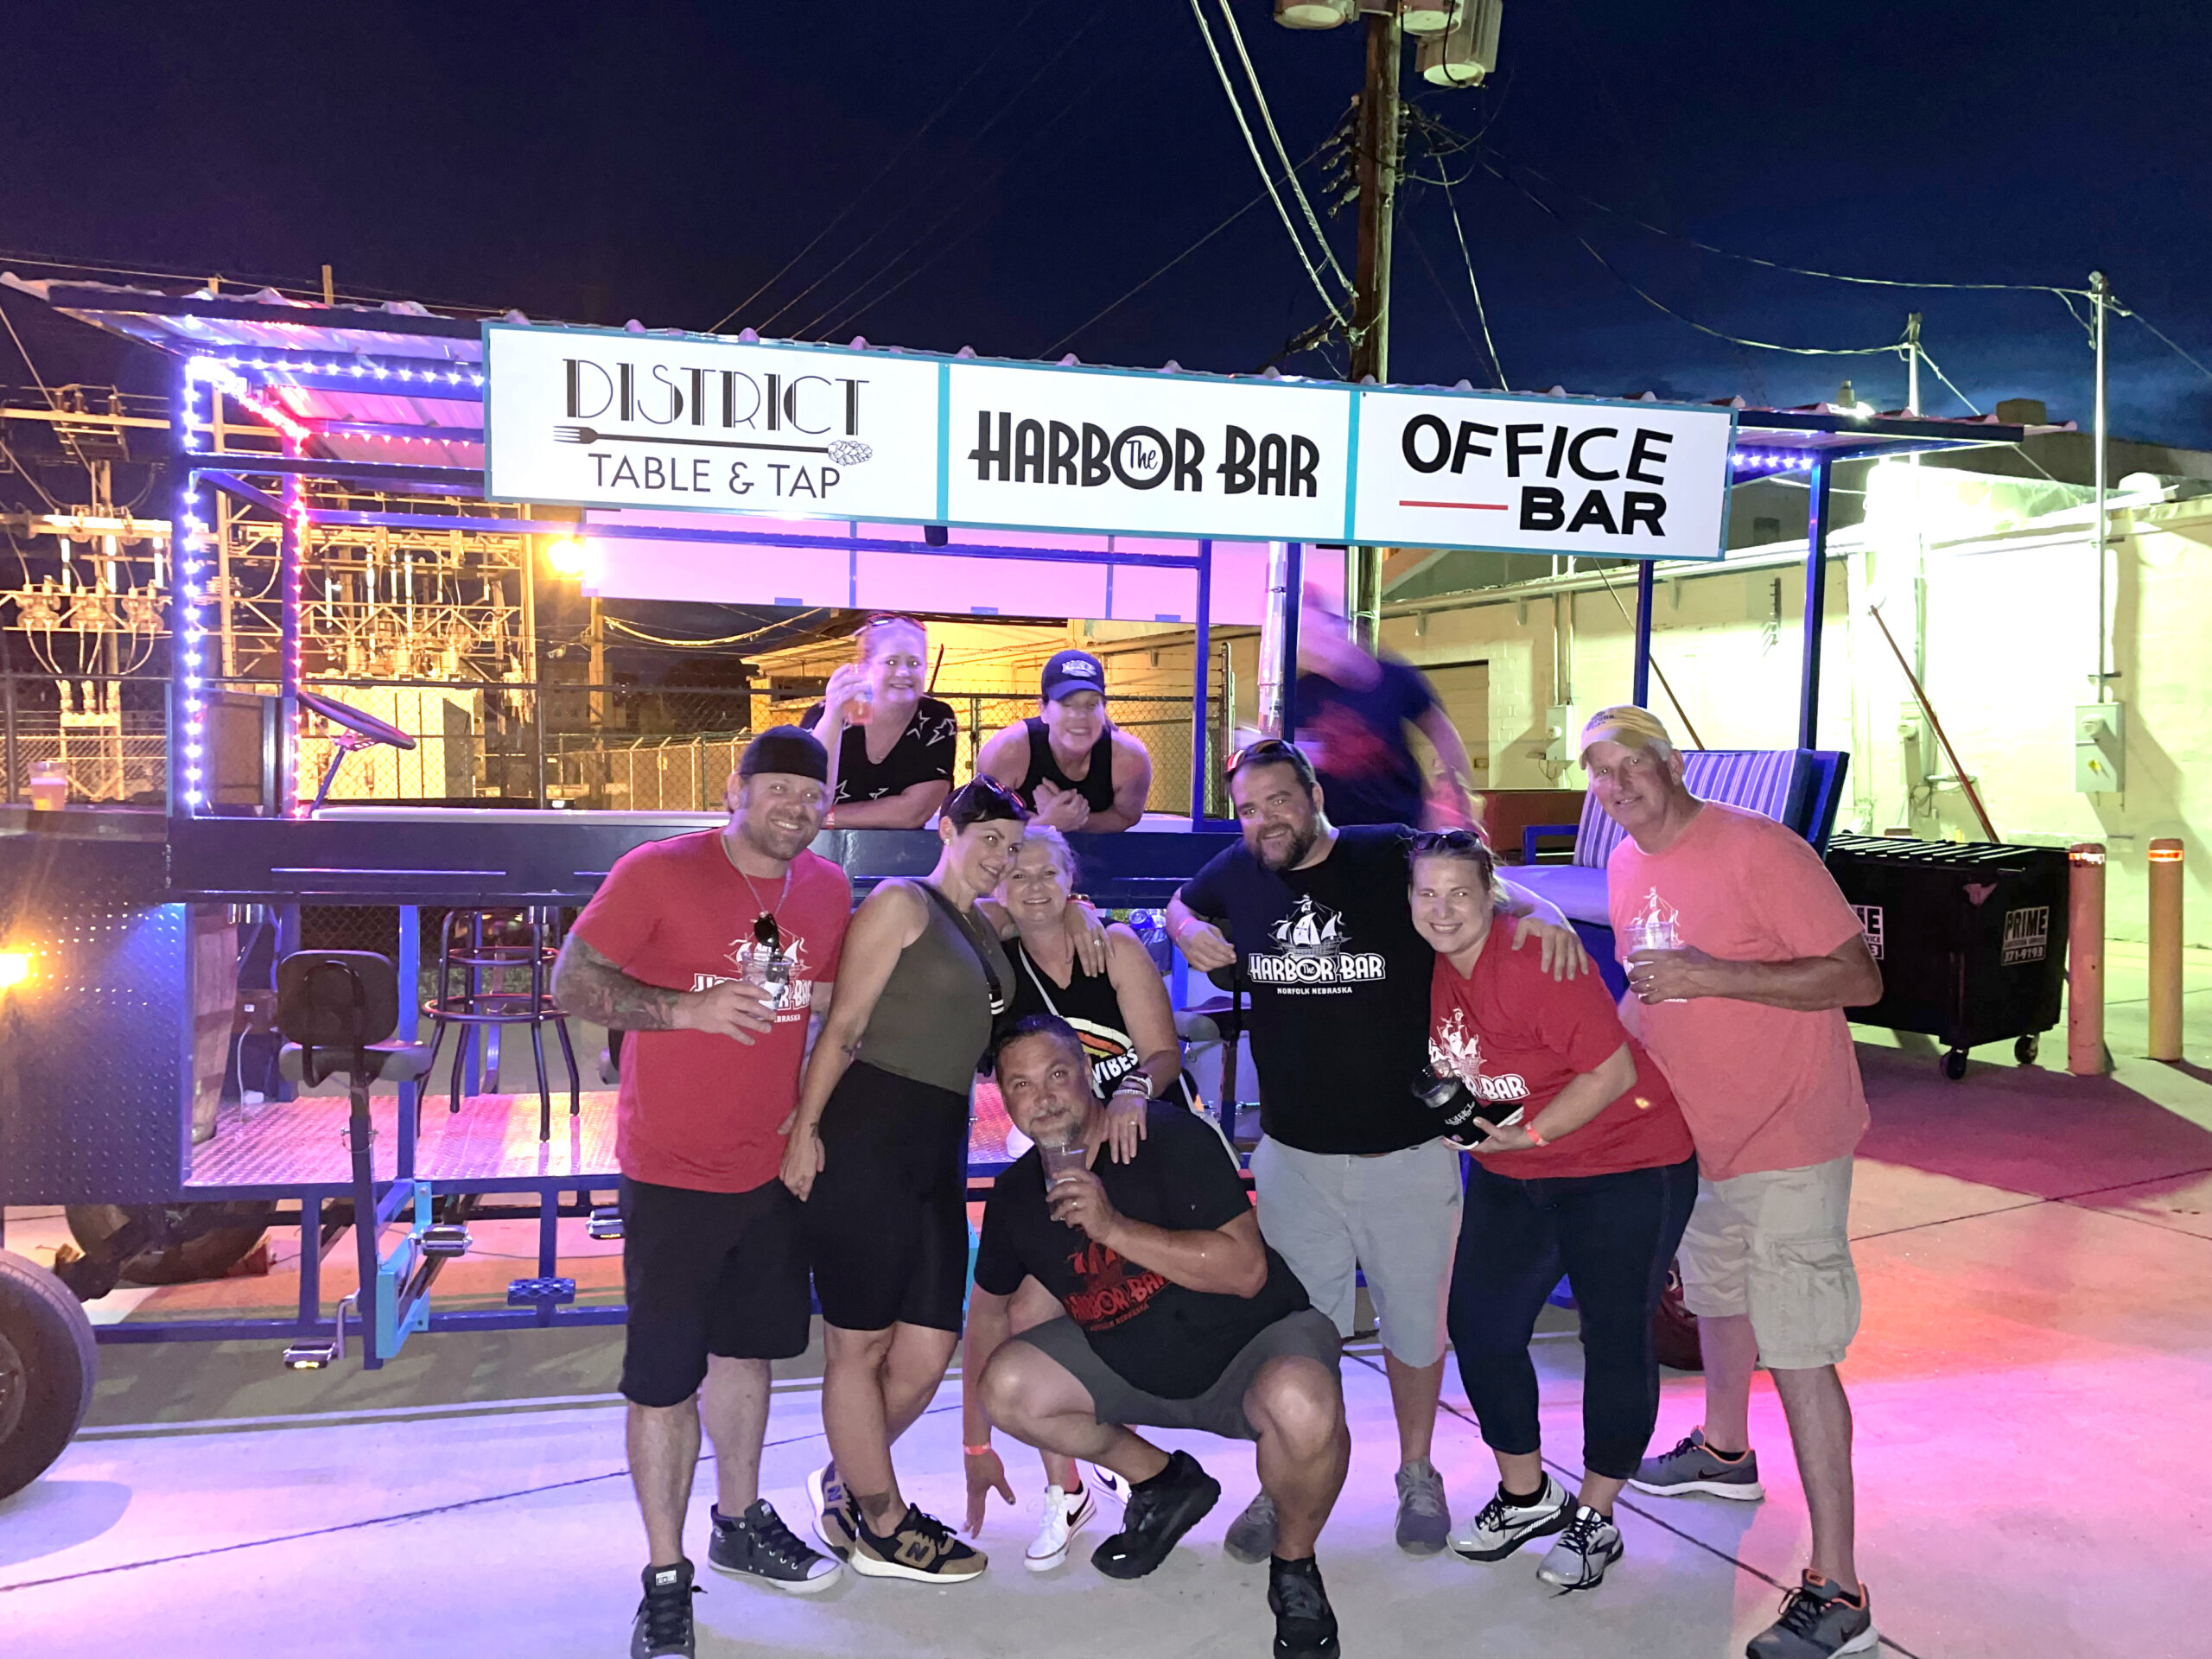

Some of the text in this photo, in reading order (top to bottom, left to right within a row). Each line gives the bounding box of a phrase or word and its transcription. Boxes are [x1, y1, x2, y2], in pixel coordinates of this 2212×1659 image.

[563, 359, 869, 435] DISTRICT
[968, 410, 1319, 497] HARBOR BAR
[1126, 440, 1158, 470] The
[1402, 414, 1674, 486] OFFICE
[588, 453, 841, 499] TABLE & TAP
[1520, 486, 1668, 537] BAR
[2005, 907, 2047, 940] PRIME
[1250, 955, 1383, 982] HARBOR BAR
[1091, 1047, 1139, 1084] VIBES
[1480, 1076, 1527, 1100] BAR
